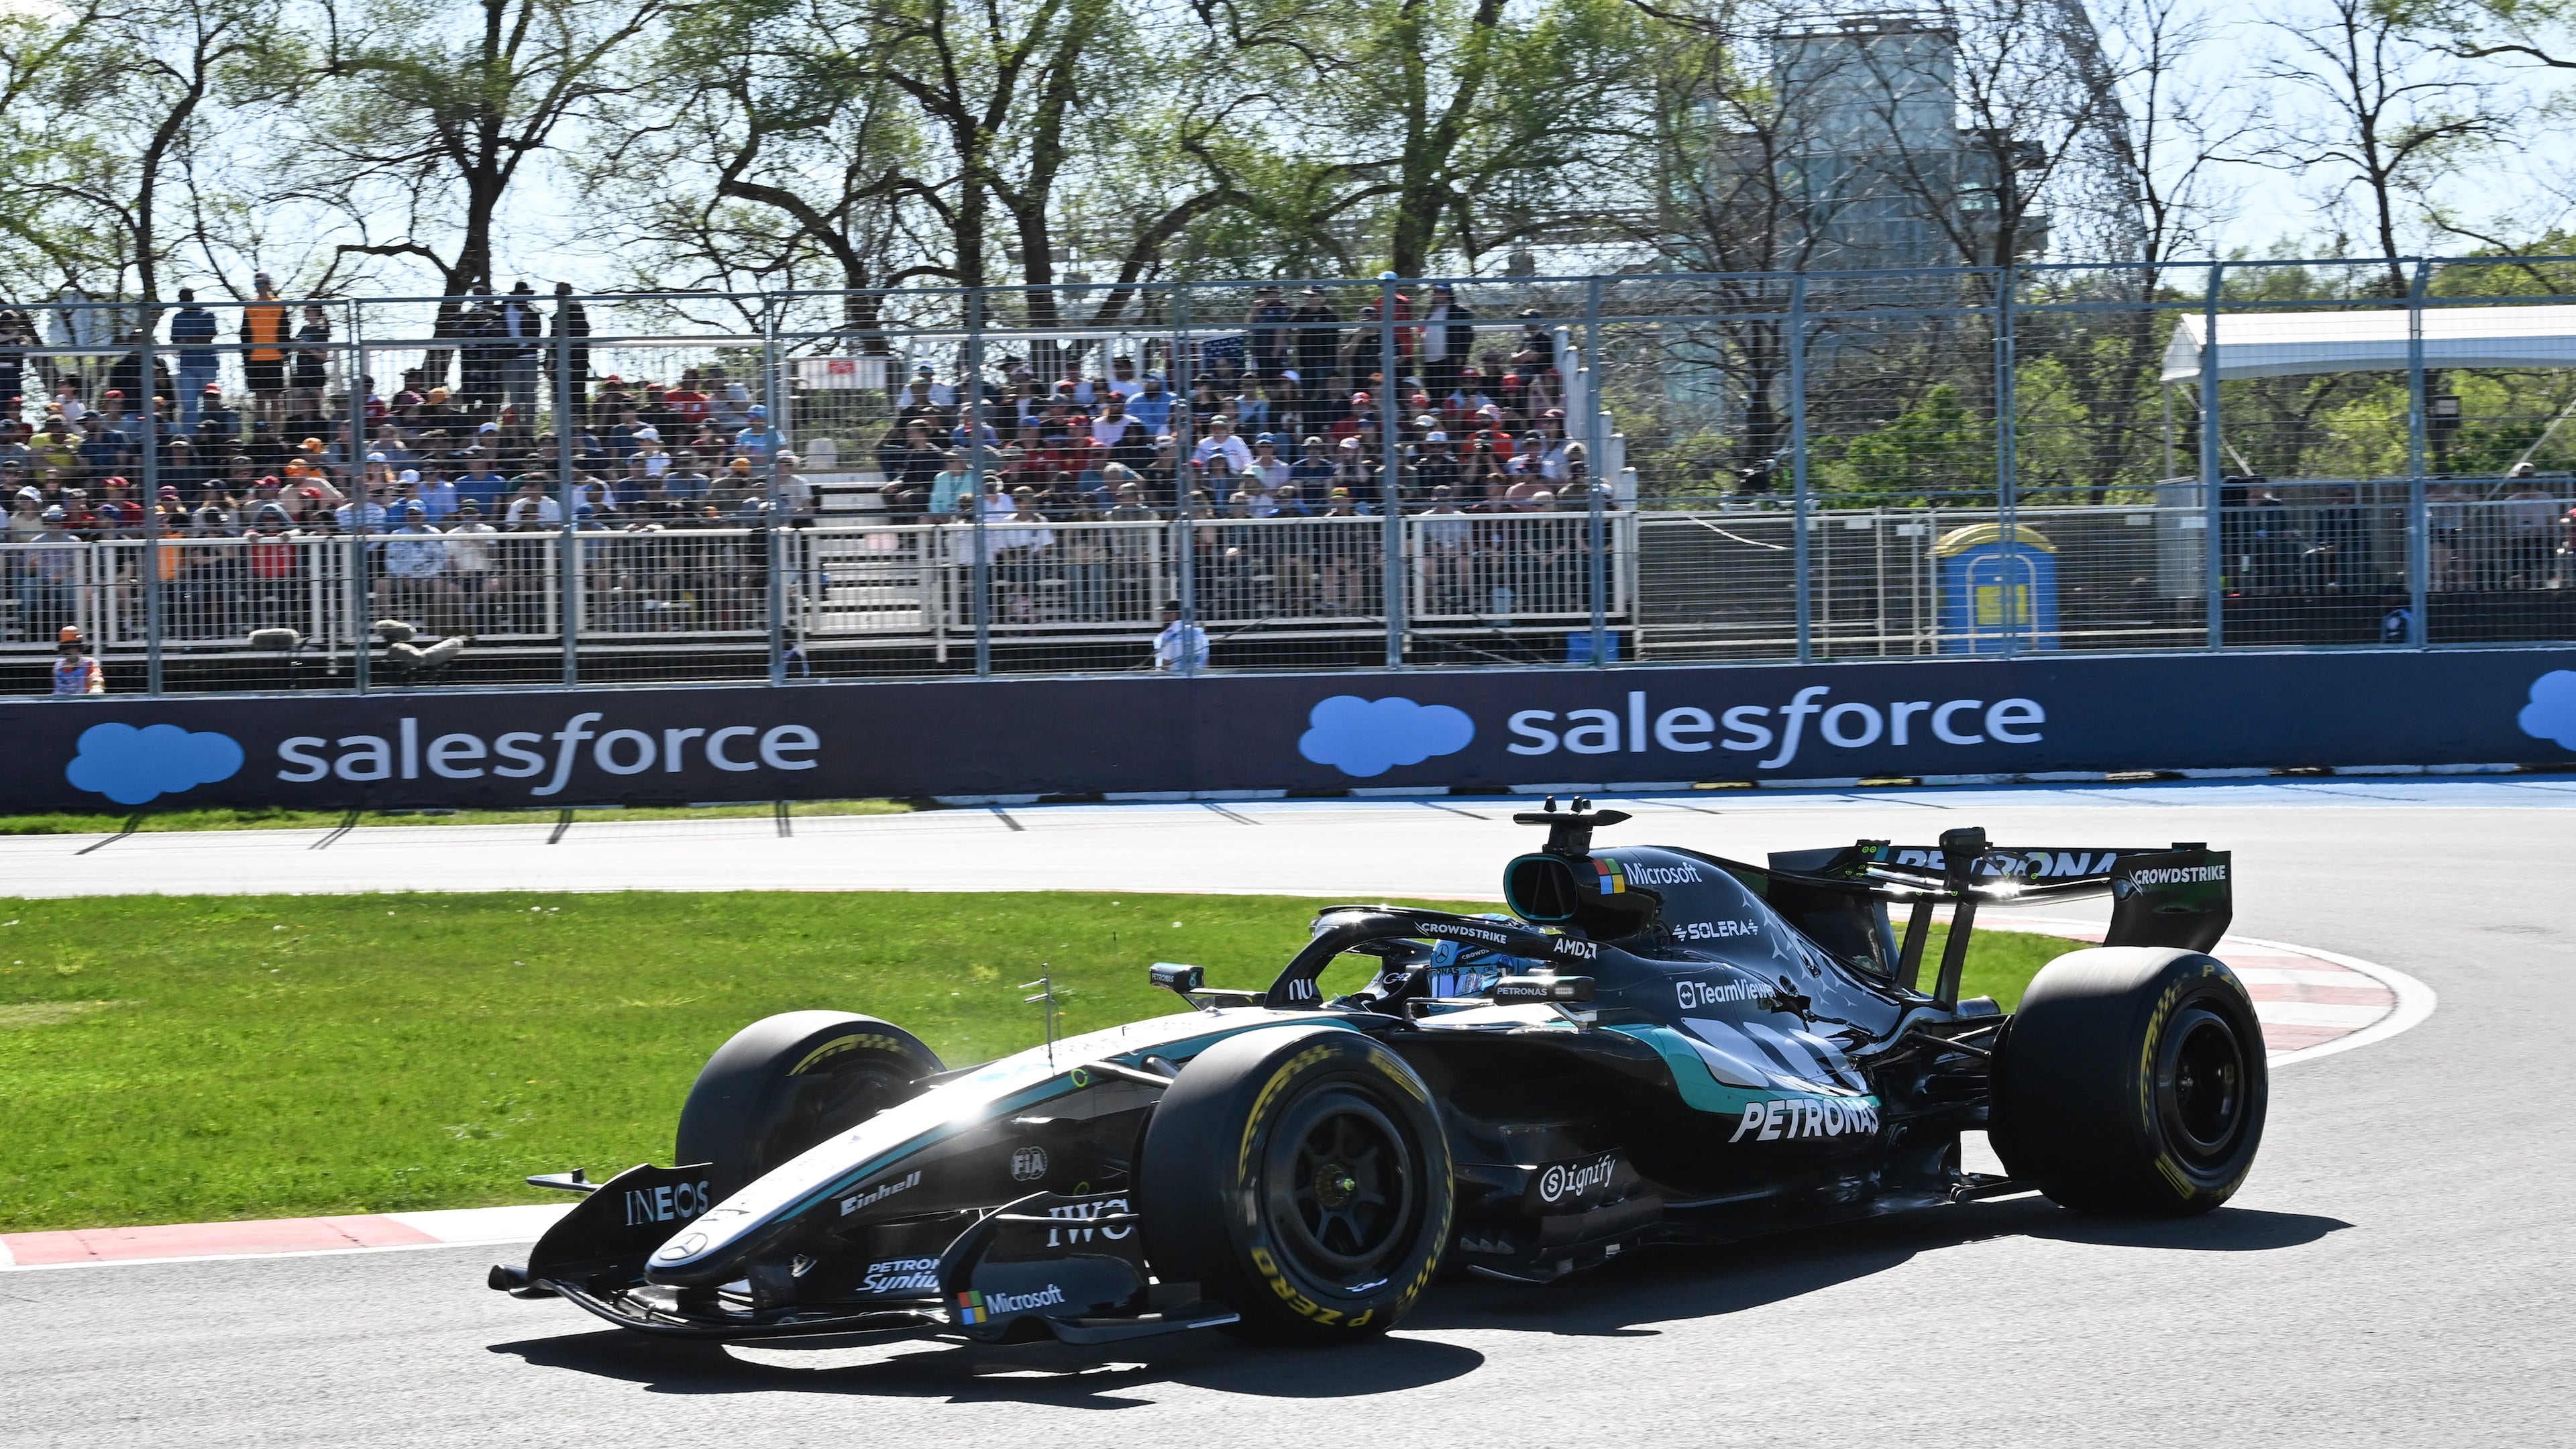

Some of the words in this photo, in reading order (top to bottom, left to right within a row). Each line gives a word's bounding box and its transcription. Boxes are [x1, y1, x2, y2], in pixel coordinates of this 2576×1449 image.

[1507, 686, 2045, 769] salesforce
[276, 712, 820, 797] salesforce
[1623, 861, 1703, 885] Microsoft
[2134, 865, 2226, 885] CROWDSTRIKE
[1421, 922, 1507, 945] CROWDSTRIKE
[1687, 920, 1751, 940] SOLERA
[1554, 937, 1587, 957] AMD
[1383, 972, 1412, 985] G42
[1497, 987, 1548, 996] PETRONAS
[1695, 978, 1778, 1005] TeamViewer
[1727, 1098, 1879, 1143] PETRONAS
[625, 1180, 709, 1226] INEOS
[841, 1170, 922, 1217] Einhell
[1046, 1198, 1132, 1247] IWC
[985, 1283, 1067, 1315] Microsoft
